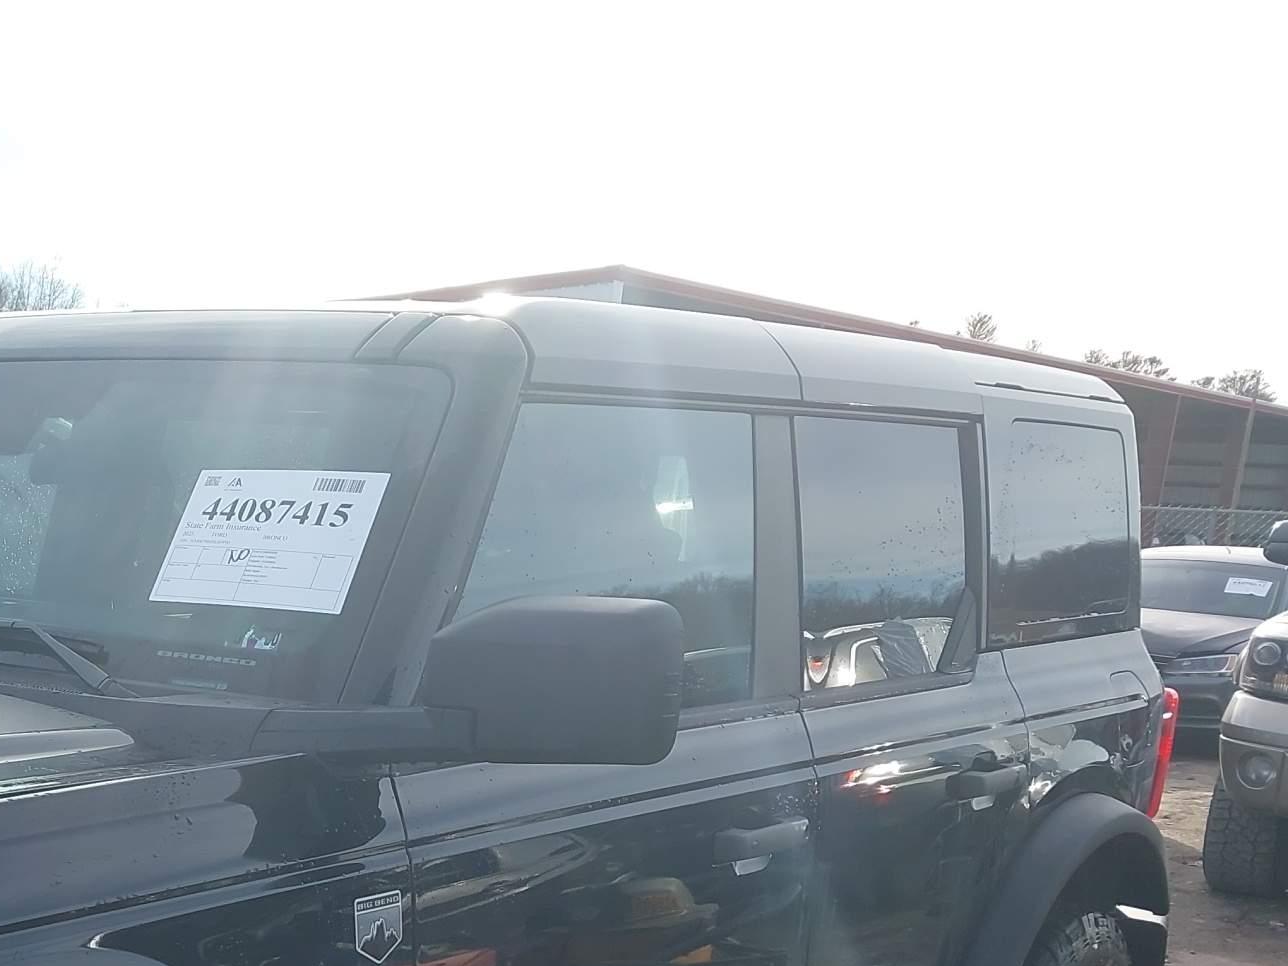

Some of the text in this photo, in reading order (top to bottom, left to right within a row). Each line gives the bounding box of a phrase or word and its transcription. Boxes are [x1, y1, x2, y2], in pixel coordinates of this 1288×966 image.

[201, 497, 354, 529] 44087415
[184, 521, 262, 532] State Farm Insurance
[357, 895, 399, 910] BIG BEND
